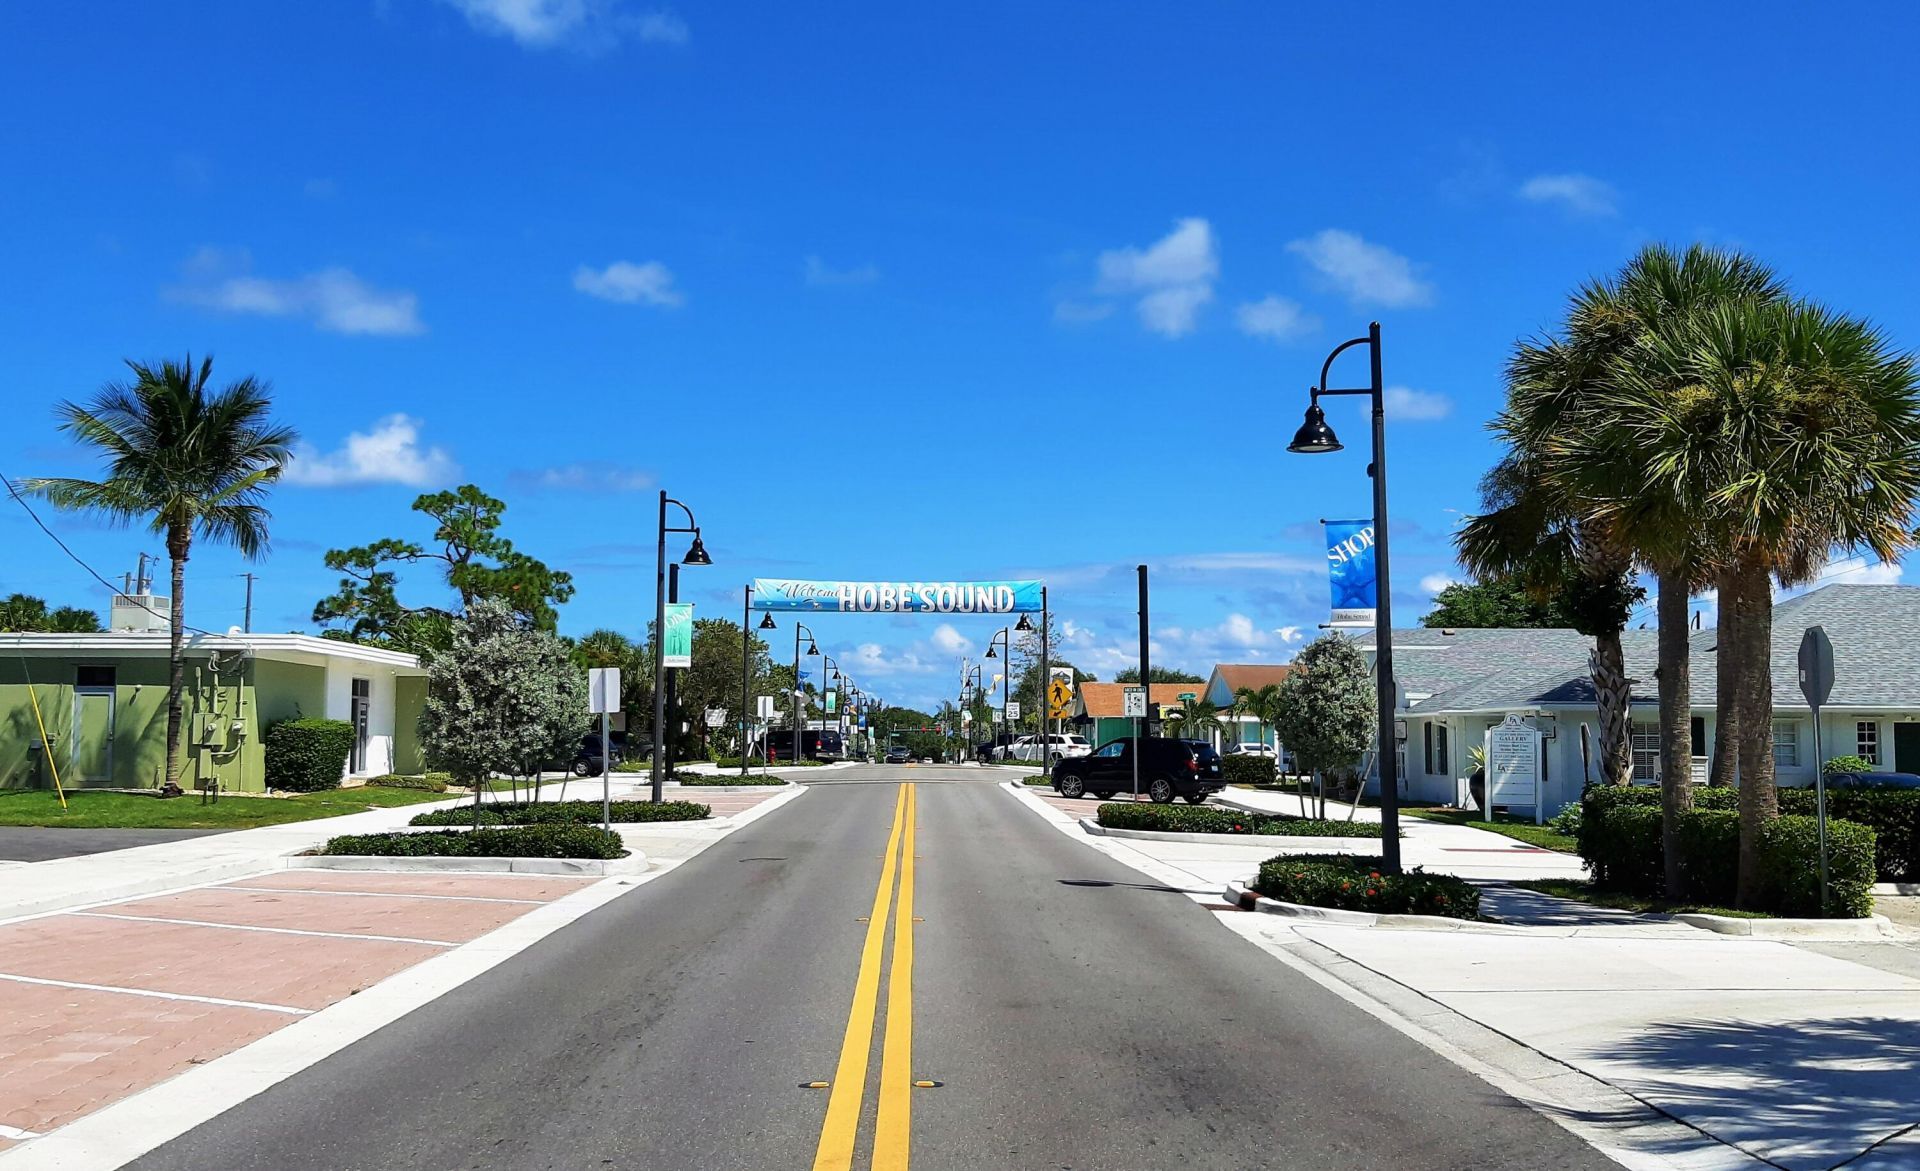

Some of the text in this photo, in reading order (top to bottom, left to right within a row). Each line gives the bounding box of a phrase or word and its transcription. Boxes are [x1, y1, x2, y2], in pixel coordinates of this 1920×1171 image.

[1327, 527, 1374, 568] SHOP
[838, 585, 1016, 612] HOBE SOUND
